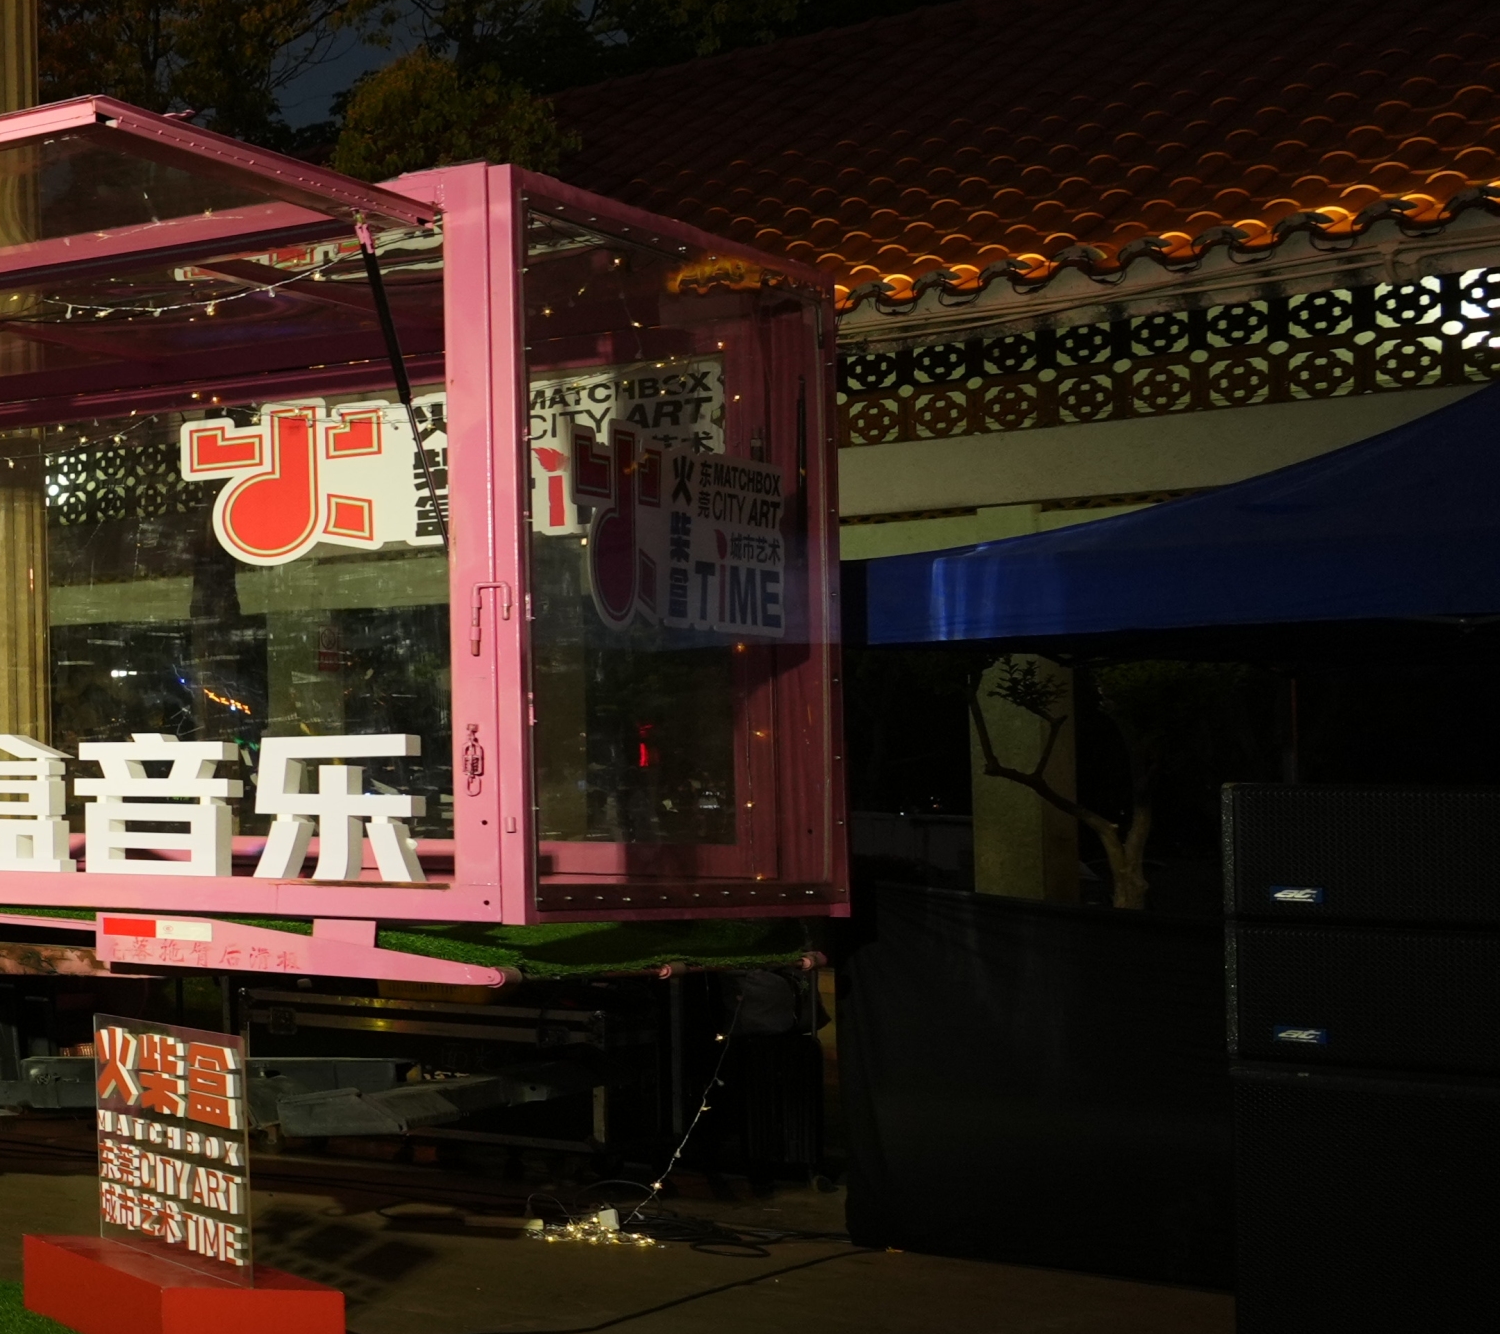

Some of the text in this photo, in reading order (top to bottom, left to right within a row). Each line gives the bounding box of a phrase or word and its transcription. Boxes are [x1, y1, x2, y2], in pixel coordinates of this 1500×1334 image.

[713, 463, 781, 497] MATCHBOX
[712, 491, 781, 529] CITY ART
[730, 532, 781, 565] 城市艺术
[96, 1026, 242, 1130] 火柴盒
[97, 1109, 242, 1167] MATCHBOX
